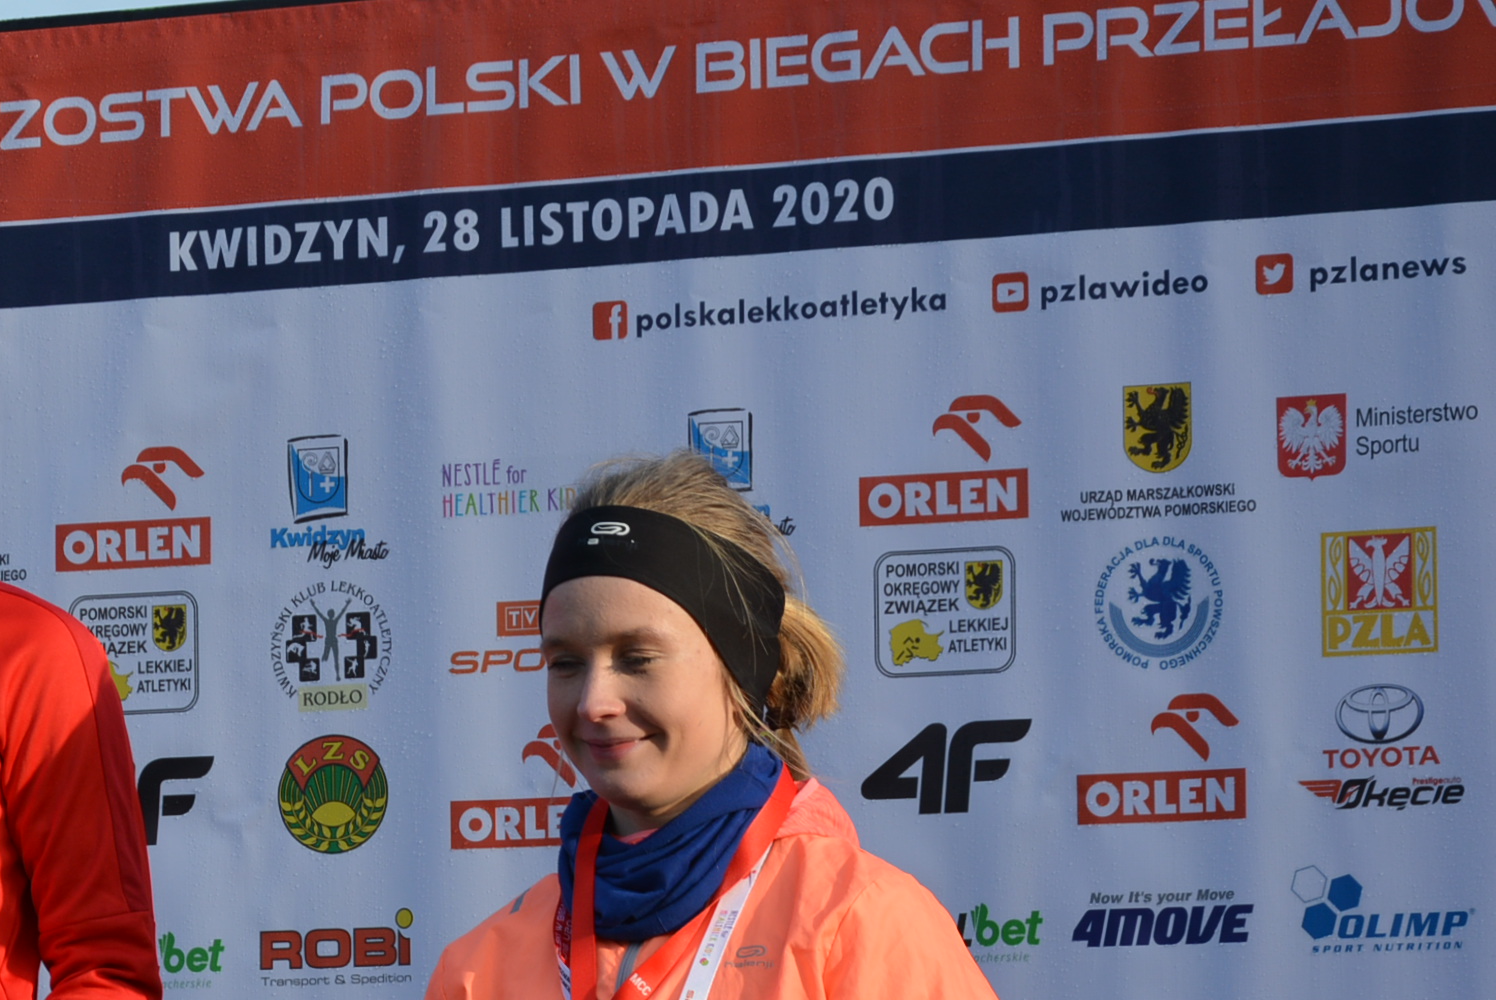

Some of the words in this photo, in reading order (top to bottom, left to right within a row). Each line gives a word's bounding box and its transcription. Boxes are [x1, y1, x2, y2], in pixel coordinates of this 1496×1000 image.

[319, 54, 582, 125] POLSKI
[600, 45, 677, 100] W
[695, 15, 1021, 94] BIEGACH
[169, 215, 405, 272] KWIDZYN,
[423, 209, 481, 254] 28
[502, 188, 755, 249] LISTOPADA
[771, 177, 896, 229] 2020
[1308, 251, 1468, 293] pzlanews
[1040, 269, 1210, 310] pzlawideo
[635, 286, 948, 338] polskalekkoatletyka
[1356, 403, 1478, 429] Ministerstwo
[1356, 433, 1420, 458] Sportu
[506, 466, 527, 484] for
[442, 489, 540, 518] HEALTHIER
[867, 475, 1019, 518] ORLEN
[1079, 490, 1123, 506] URZĄD
[1126, 481, 1236, 504] MARSZAŁKOWSKI
[1060, 502, 1161, 524] WOJEWÓDZTWA
[1164, 497, 1257, 519] POMORSKIEGO
[62, 524, 201, 565] ORLEN
[270, 525, 366, 550] Kwidzyn
[1134, 537, 1160, 552] DLA
[1162, 535, 1187, 550] DLA
[307, 540, 342, 569] Moje
[345, 538, 390, 560] Miasto
[1187, 543, 1222, 587] SPORTU
[885, 562, 960, 578] POMORSKI
[1094, 546, 1134, 615] FEDERACJA
[883, 580, 960, 600] OKRĘGOWY
[79, 605, 148, 621] POMORSKI
[884, 598, 960, 616] ZWIĄZEK
[291, 582, 326, 608] KLUB
[331, 580, 393, 695] LEKKOATLETYCZNY
[948, 618, 1009, 634] LEKKIEJ
[1158, 589, 1223, 671] POWSZECHNEGO
[1328, 612, 1432, 650] PZLA
[948, 637, 1007, 654] ATLETYKI
[137, 658, 192, 675] LEKKIEJ
[136, 678, 191, 693] ATLETYKI
[302, 688, 363, 707] RODŁO
[294, 741, 370, 777] LZS
[861, 718, 1032, 815] 4F
[1322, 746, 1441, 769] TOYOTA
[1085, 776, 1236, 818] ORLEN
[1089, 892, 1122, 904] Now
[1128, 890, 1152, 903] It's
[1157, 890, 1191, 905] your
[1196, 888, 1235, 902] Move
[1071, 903, 1254, 948] 4MOVE
[1337, 910, 1469, 939] OLIMP
[1312, 943, 1364, 954] SPORT
[1374, 941, 1464, 952] NUTRITION
[261, 976, 332, 988] Transport
[334, 975, 347, 985] &
[350, 972, 412, 985] Spedition
[630, 972, 652, 996] MCC
